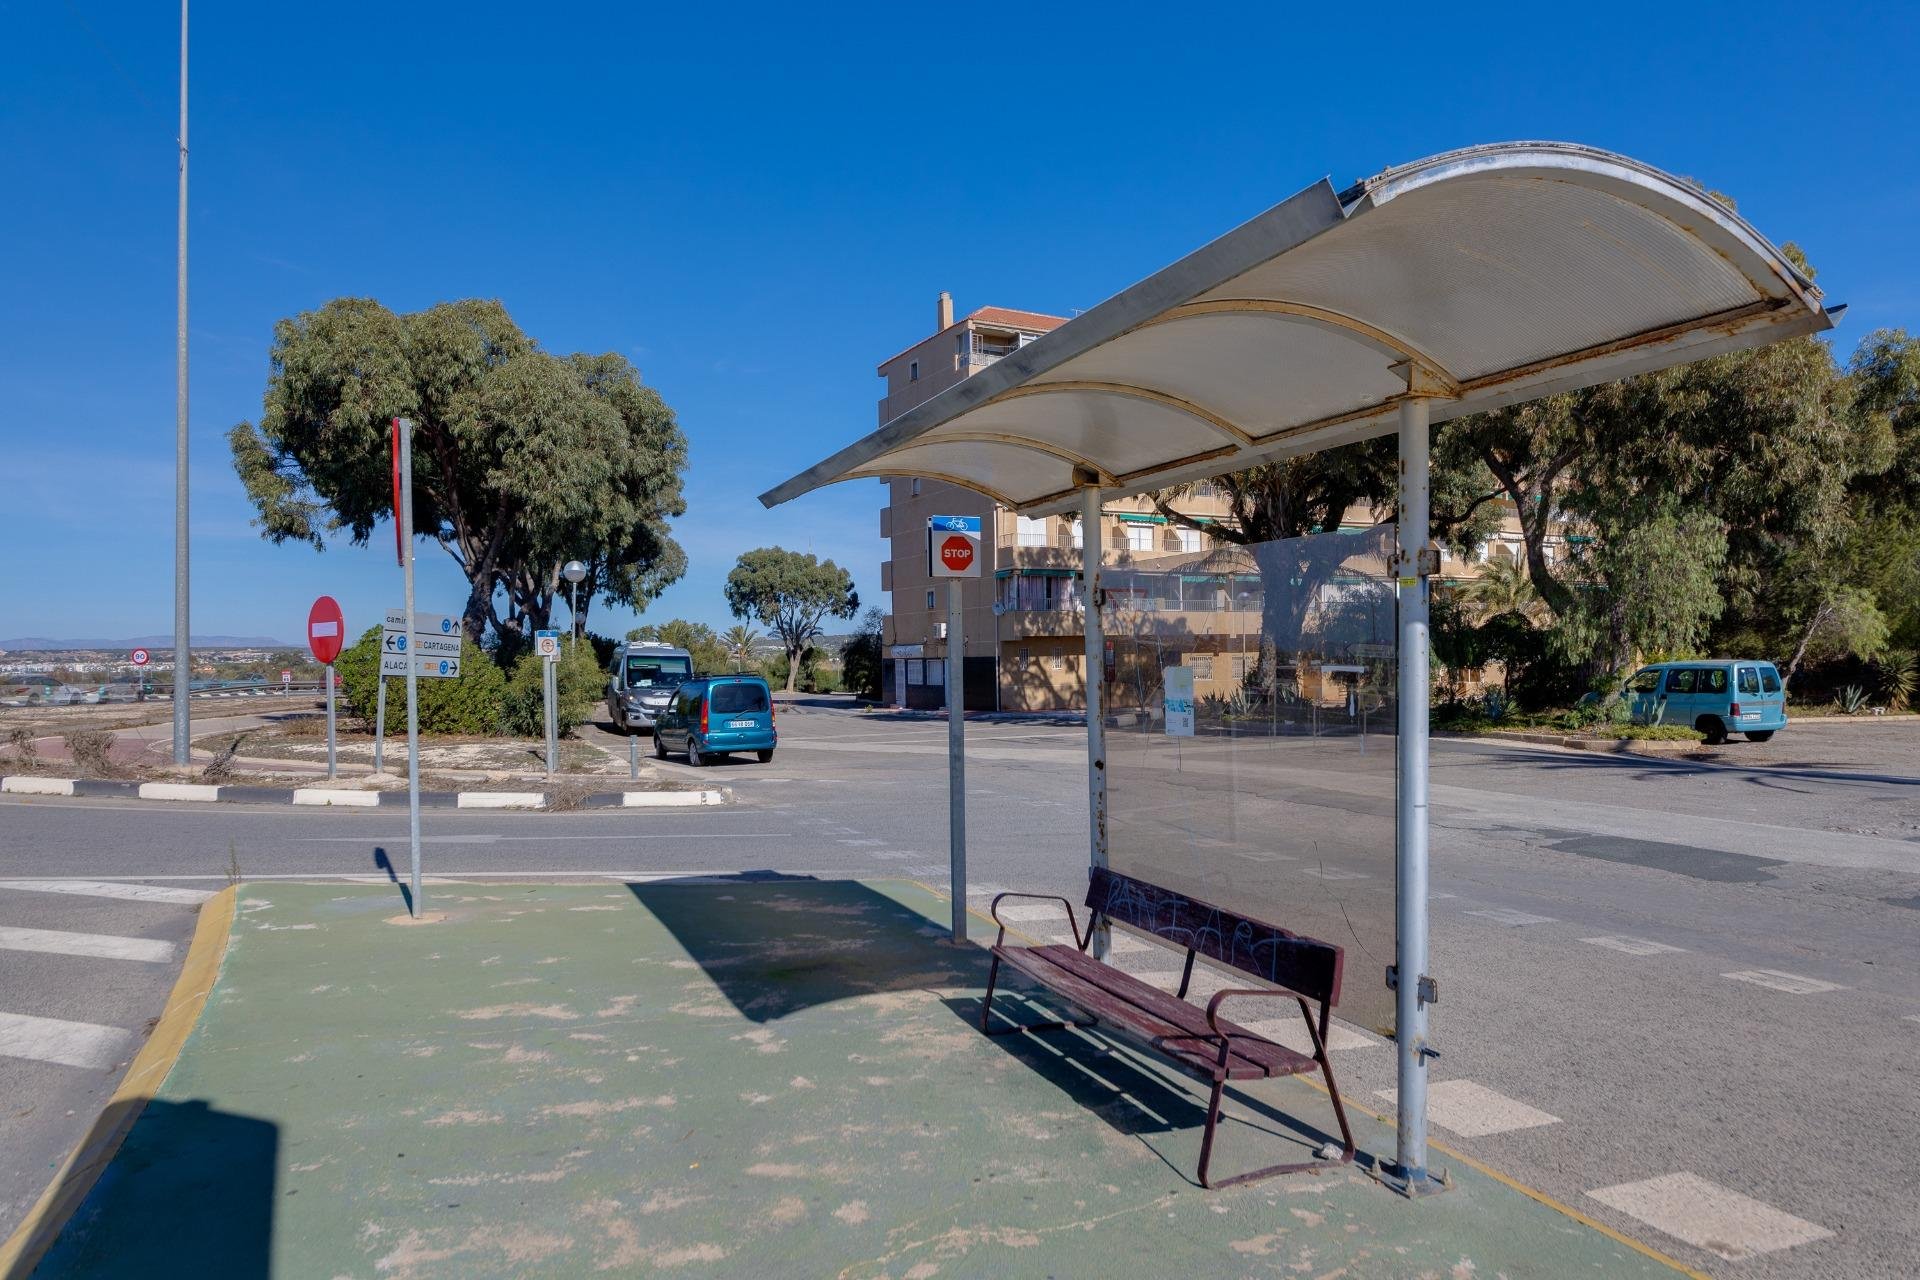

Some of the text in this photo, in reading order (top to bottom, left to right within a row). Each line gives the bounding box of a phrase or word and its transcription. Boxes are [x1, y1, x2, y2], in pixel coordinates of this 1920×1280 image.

[944, 549, 971, 558] STOP
[423, 641, 459, 652] CARTAGENA
[384, 661, 418, 670] ALACA
